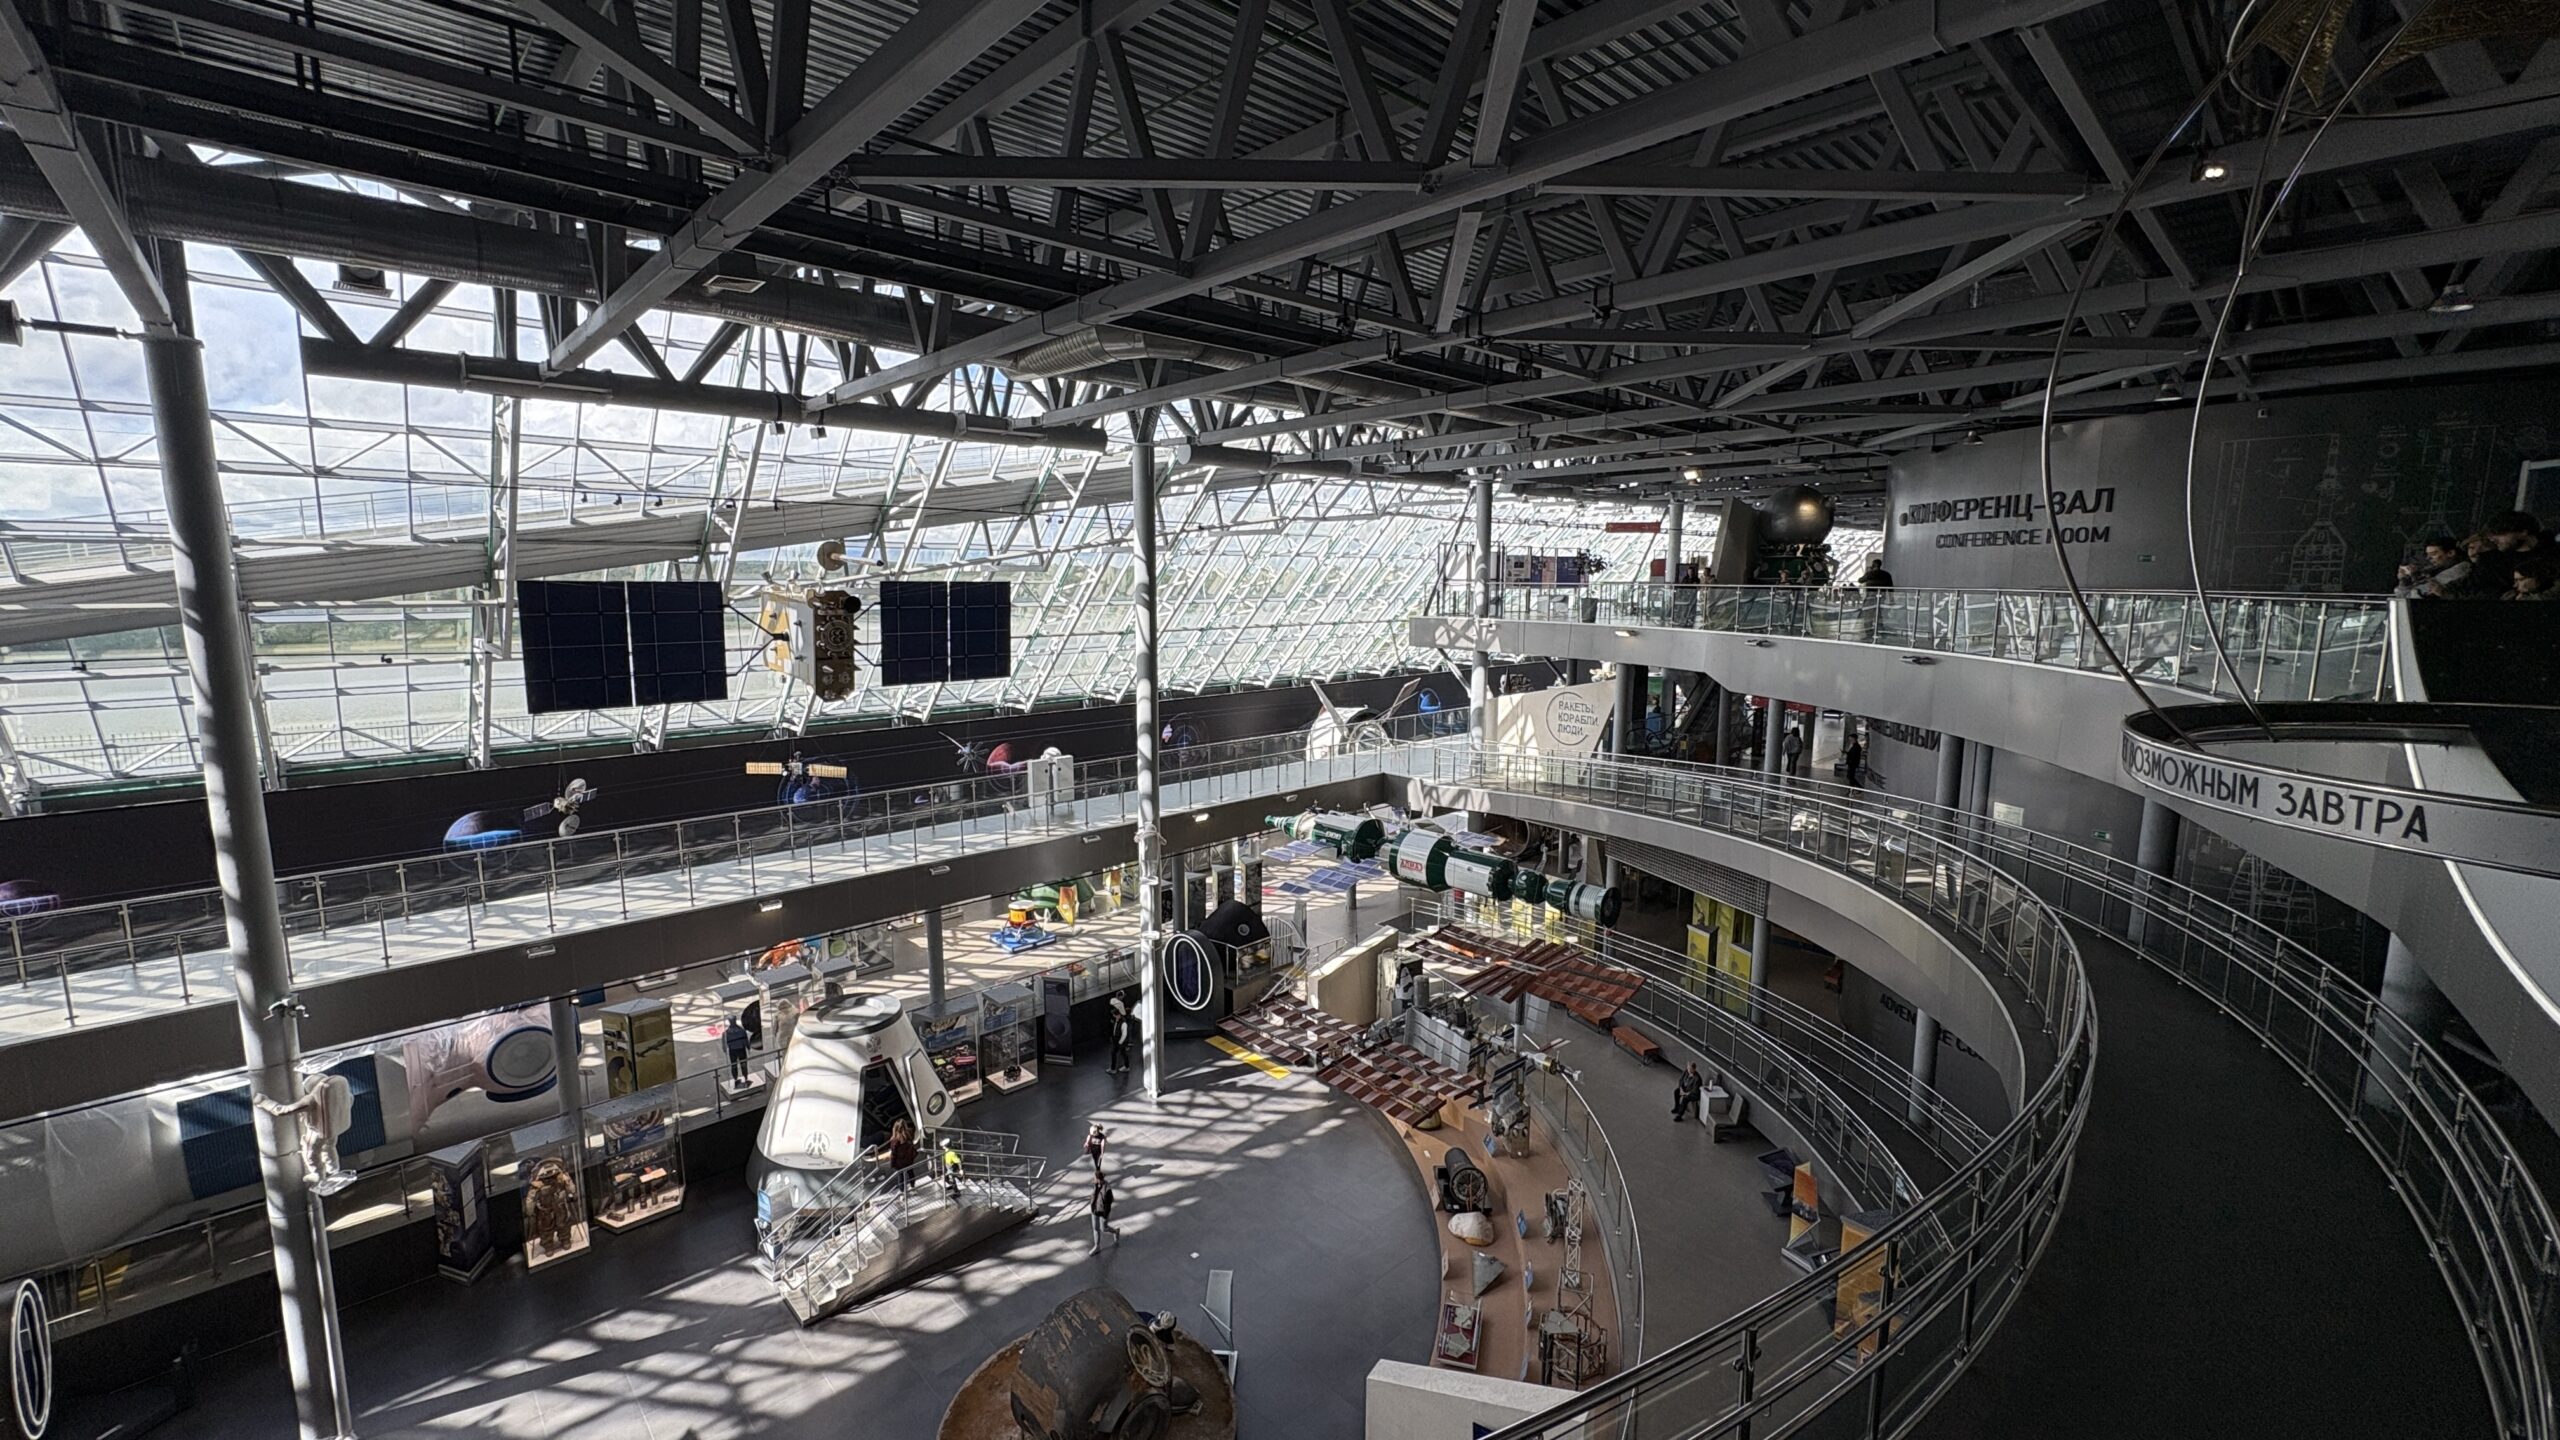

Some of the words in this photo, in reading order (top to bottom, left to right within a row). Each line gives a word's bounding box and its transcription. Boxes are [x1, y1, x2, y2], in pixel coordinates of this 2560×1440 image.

[1908, 487, 2115, 525] КОНФЕРЕНЦ-ЗАЛ
[1935, 528, 2043, 549] CONFERENCE
[2275, 782, 2429, 843] ЗАВТРА
